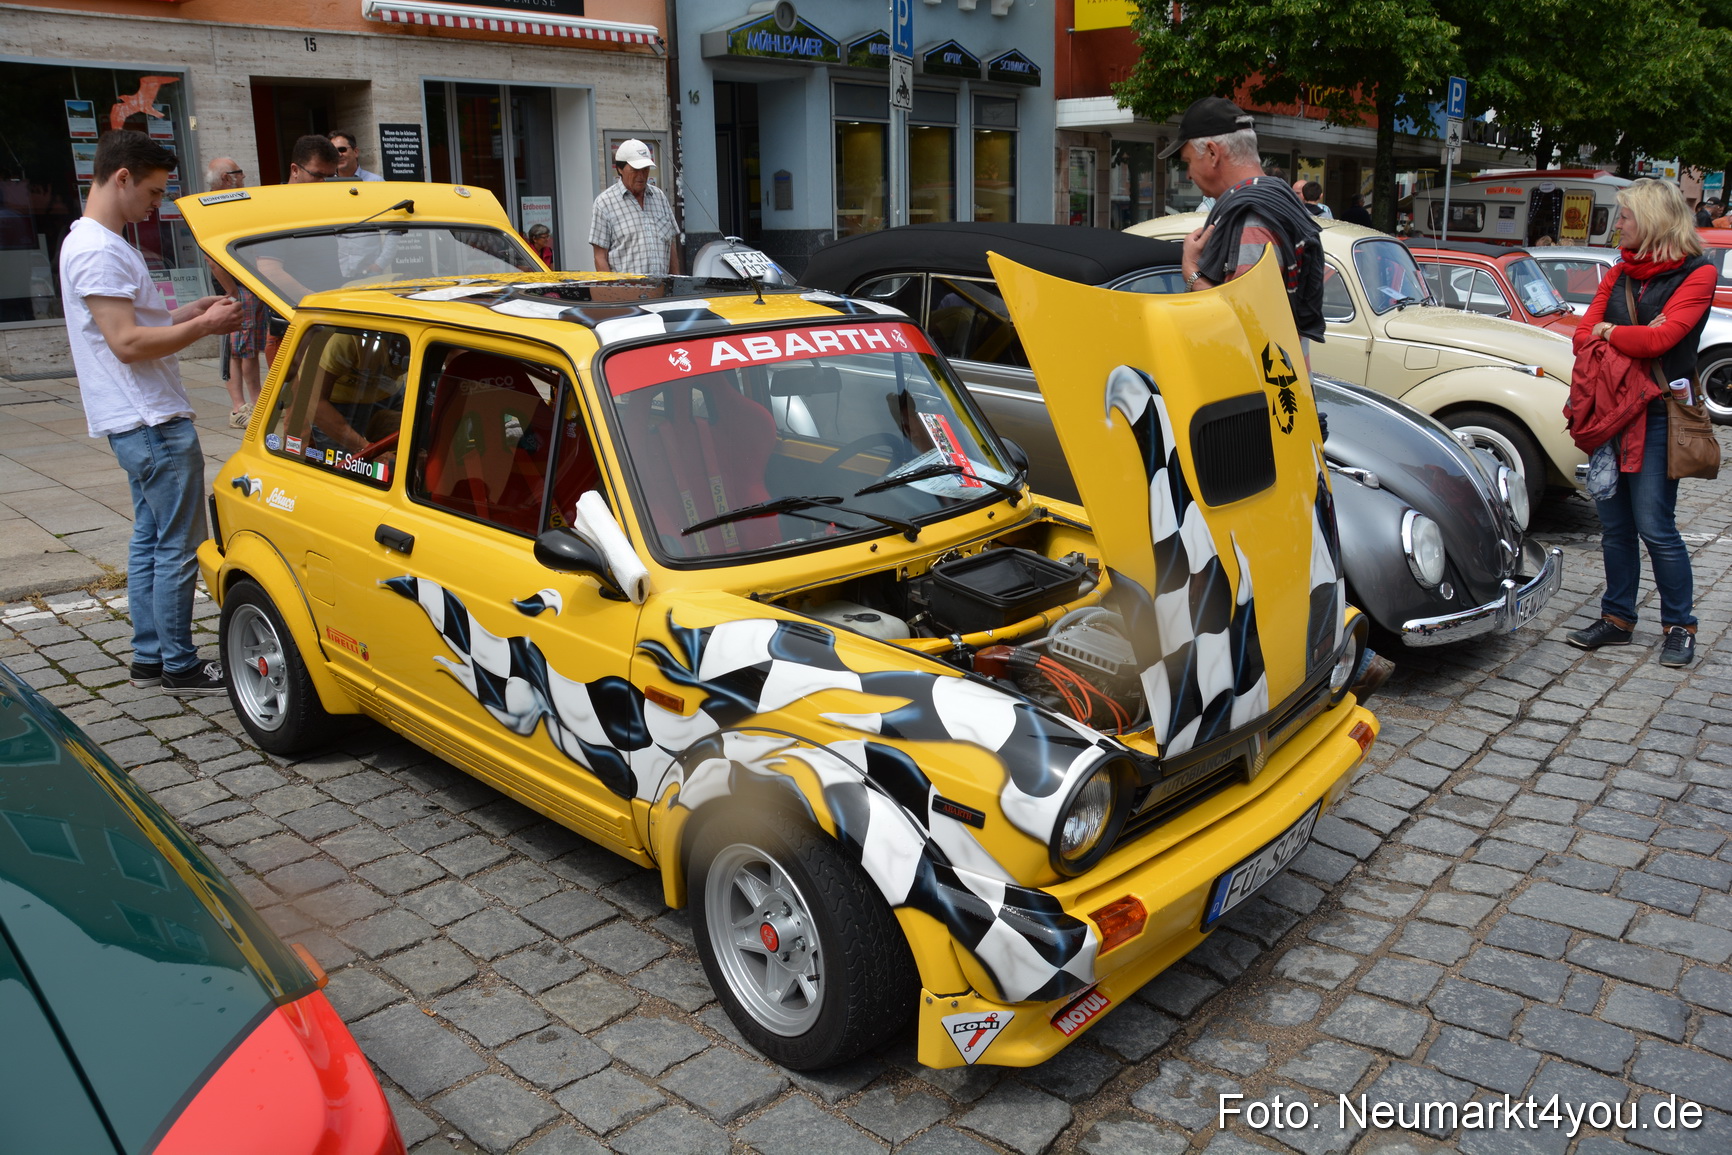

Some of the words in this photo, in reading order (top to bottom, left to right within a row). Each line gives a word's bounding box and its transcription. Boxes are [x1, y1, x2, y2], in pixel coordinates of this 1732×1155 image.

[898, 0, 908, 45] P
[304, 36, 316, 52] 15
[944, 52, 962, 65] OPTIK
[688, 89, 699, 105] 16
[1452, 82, 1462, 112] P
[710, 328, 892, 366] ABARTH
[266, 488, 295, 509] Schuco
[326, 625, 358, 654] PIRELLI
[1161, 749, 1232, 796] AUTOBIANCHI
[943, 804, 972, 820] ABARTH
[1224, 858, 1261, 909] FÜ
[956, 1022, 997, 1033] KONI
[1057, 994, 1108, 1034] MOTUL
